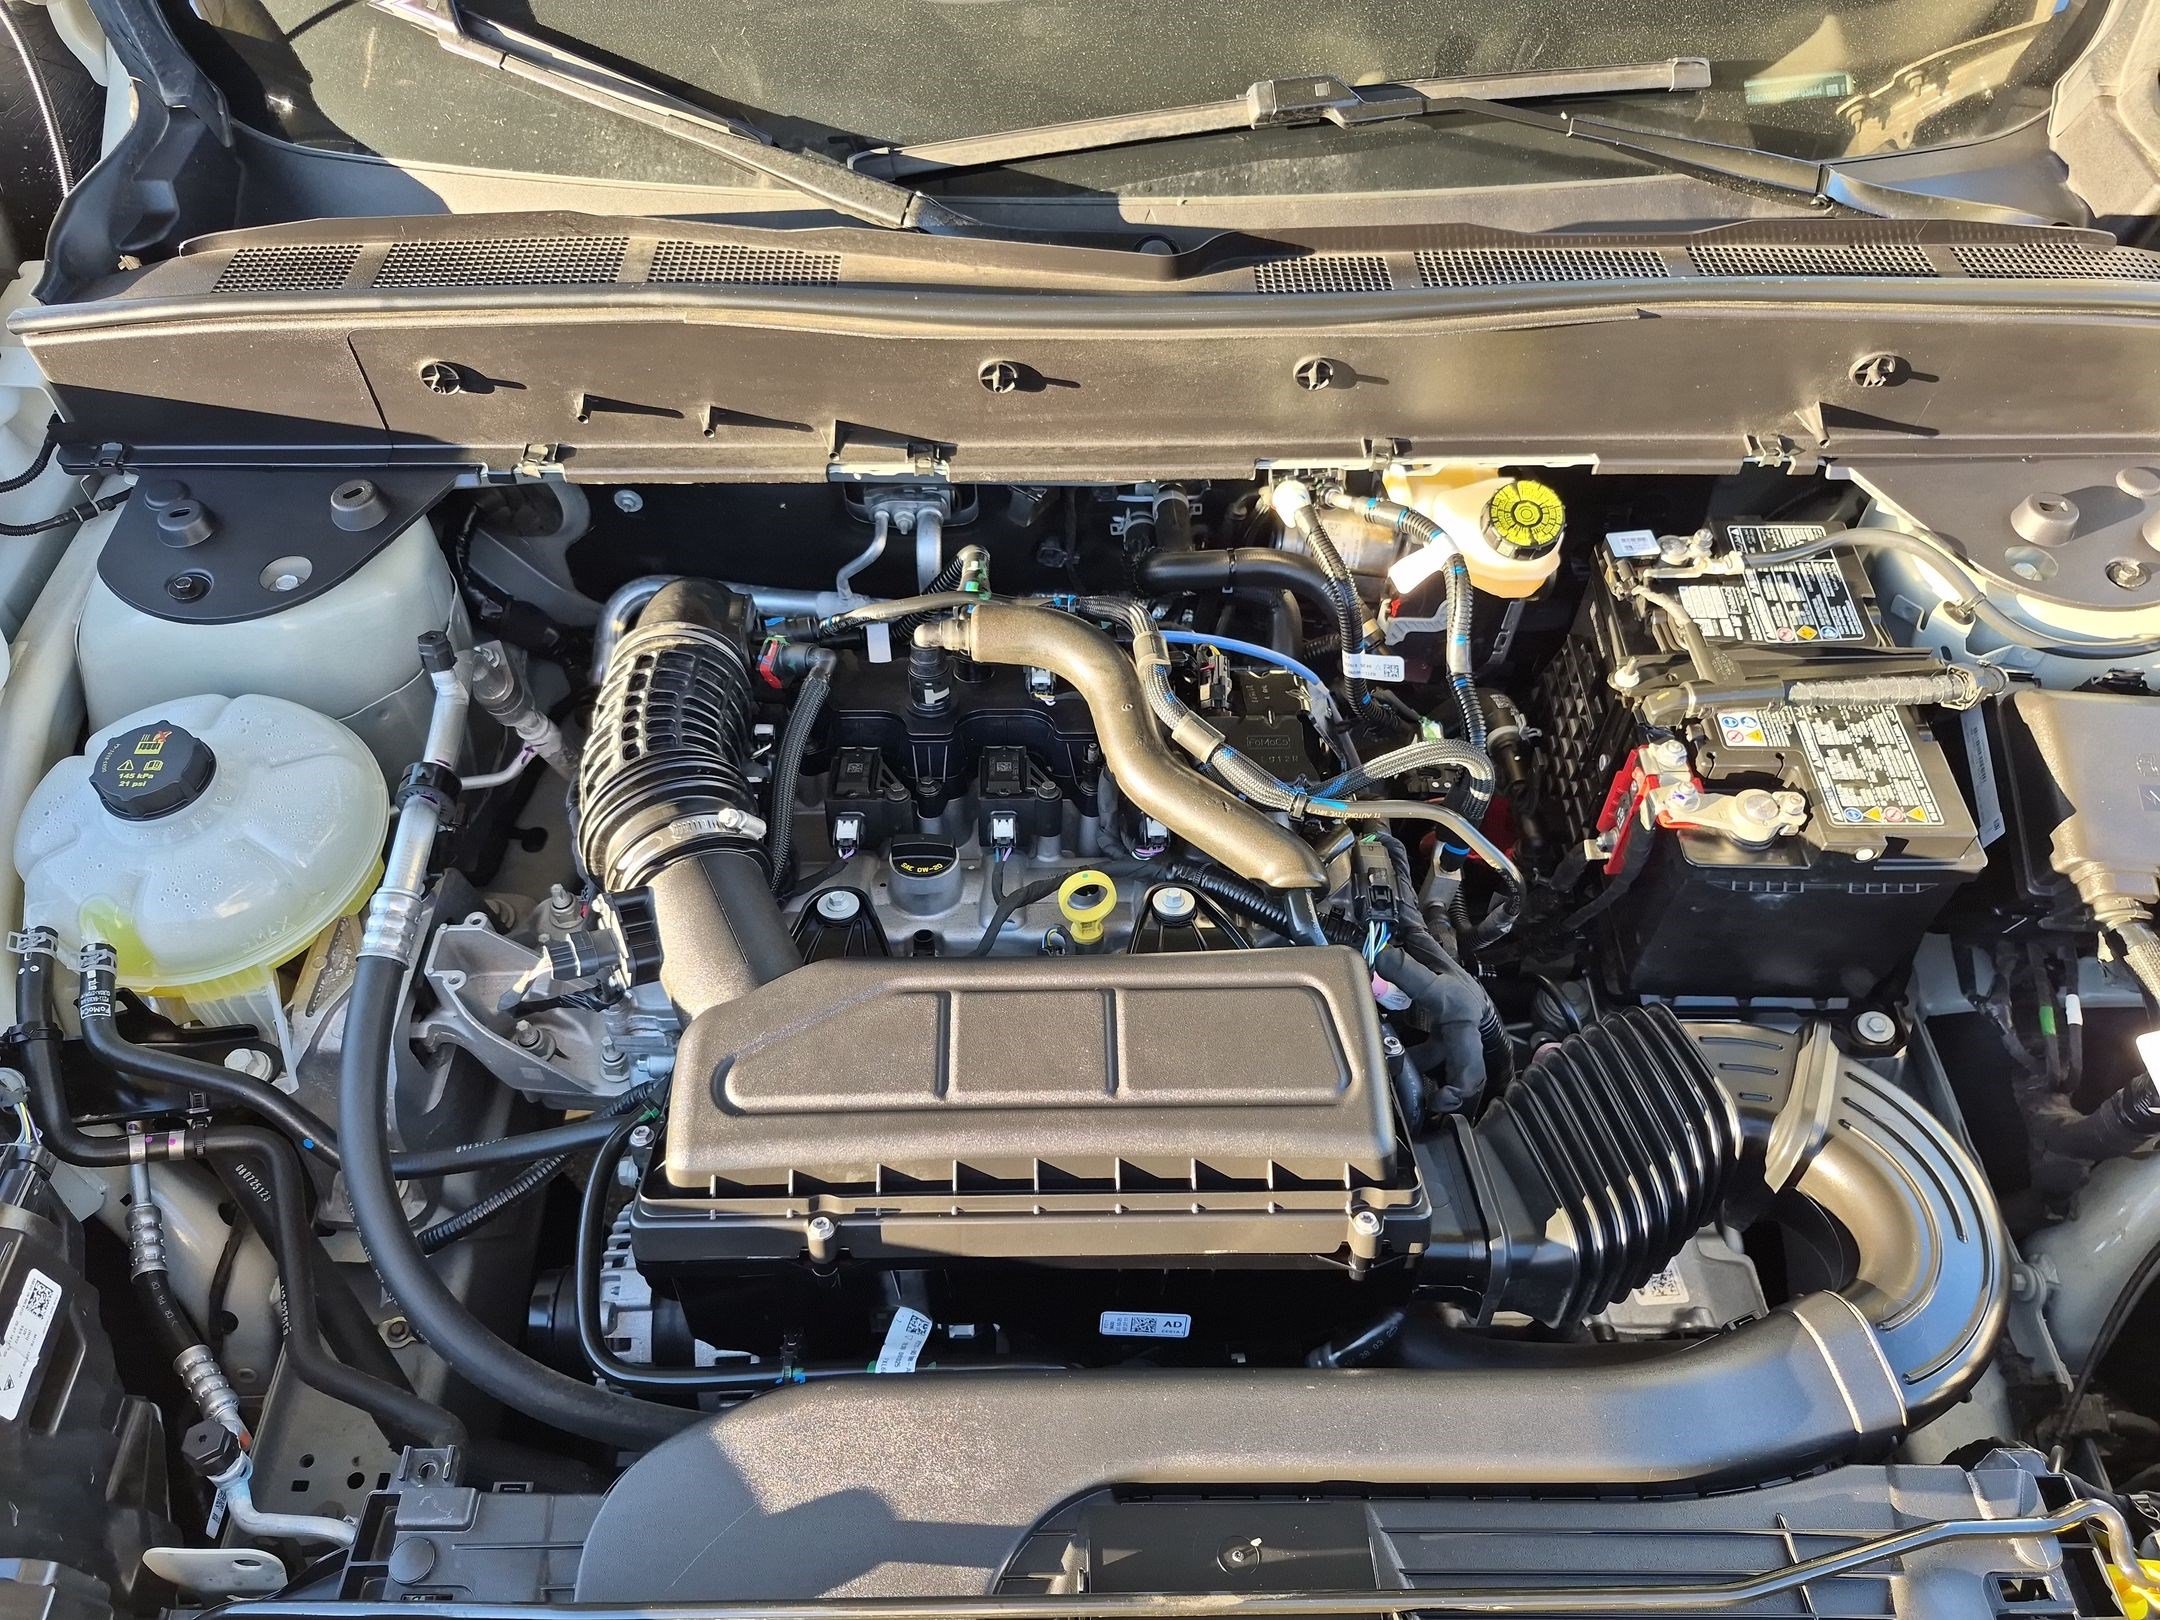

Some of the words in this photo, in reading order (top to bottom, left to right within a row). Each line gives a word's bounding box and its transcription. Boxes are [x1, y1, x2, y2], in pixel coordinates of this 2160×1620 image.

[131, 780, 147, 788] psi
[901, 862, 915, 871] SAE
[917, 863, 943, 873] 0W-20
[234, 1163, 272, 1202] 080725123
